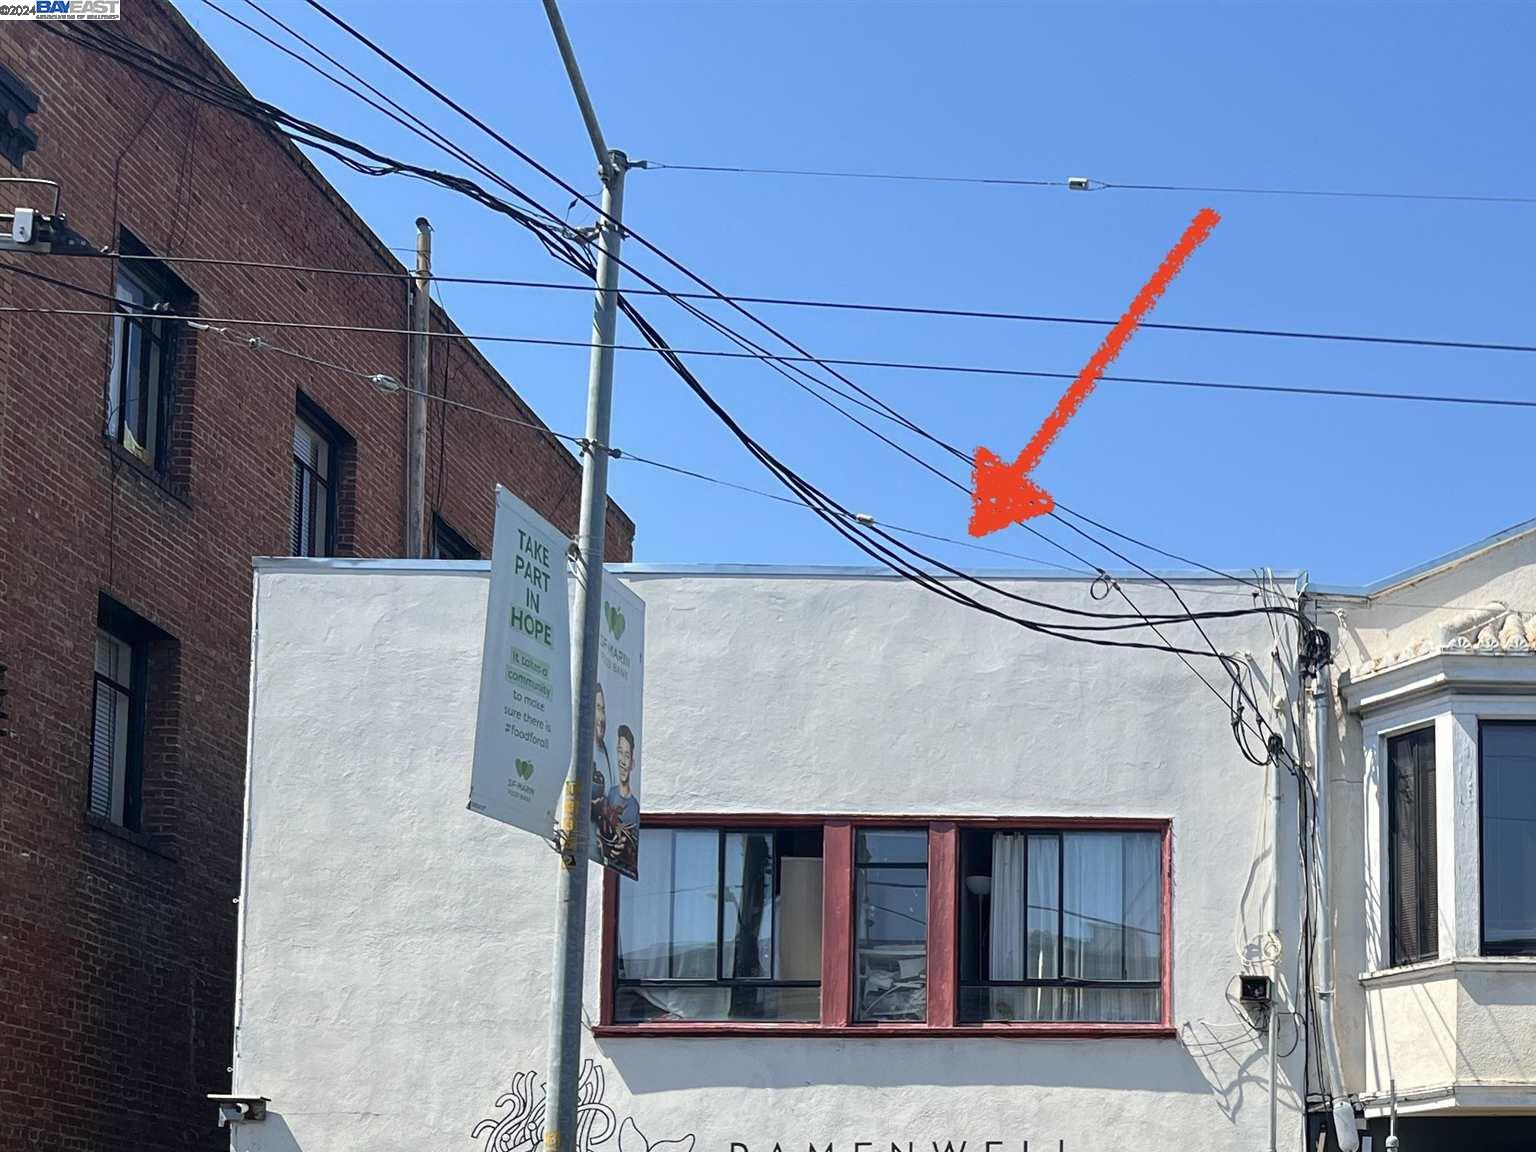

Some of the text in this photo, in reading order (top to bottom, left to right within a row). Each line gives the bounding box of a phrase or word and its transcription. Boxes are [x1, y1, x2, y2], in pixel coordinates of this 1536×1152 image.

[518, 528, 549, 569] TAKE
[515, 554, 550, 592] PART
[526, 587, 539, 613] IN
[511, 606, 552, 646] HOPE
[507, 670, 551, 698] community
[513, 689, 523, 701] to
[504, 705, 521, 720] sure
[523, 712, 544, 730] there
